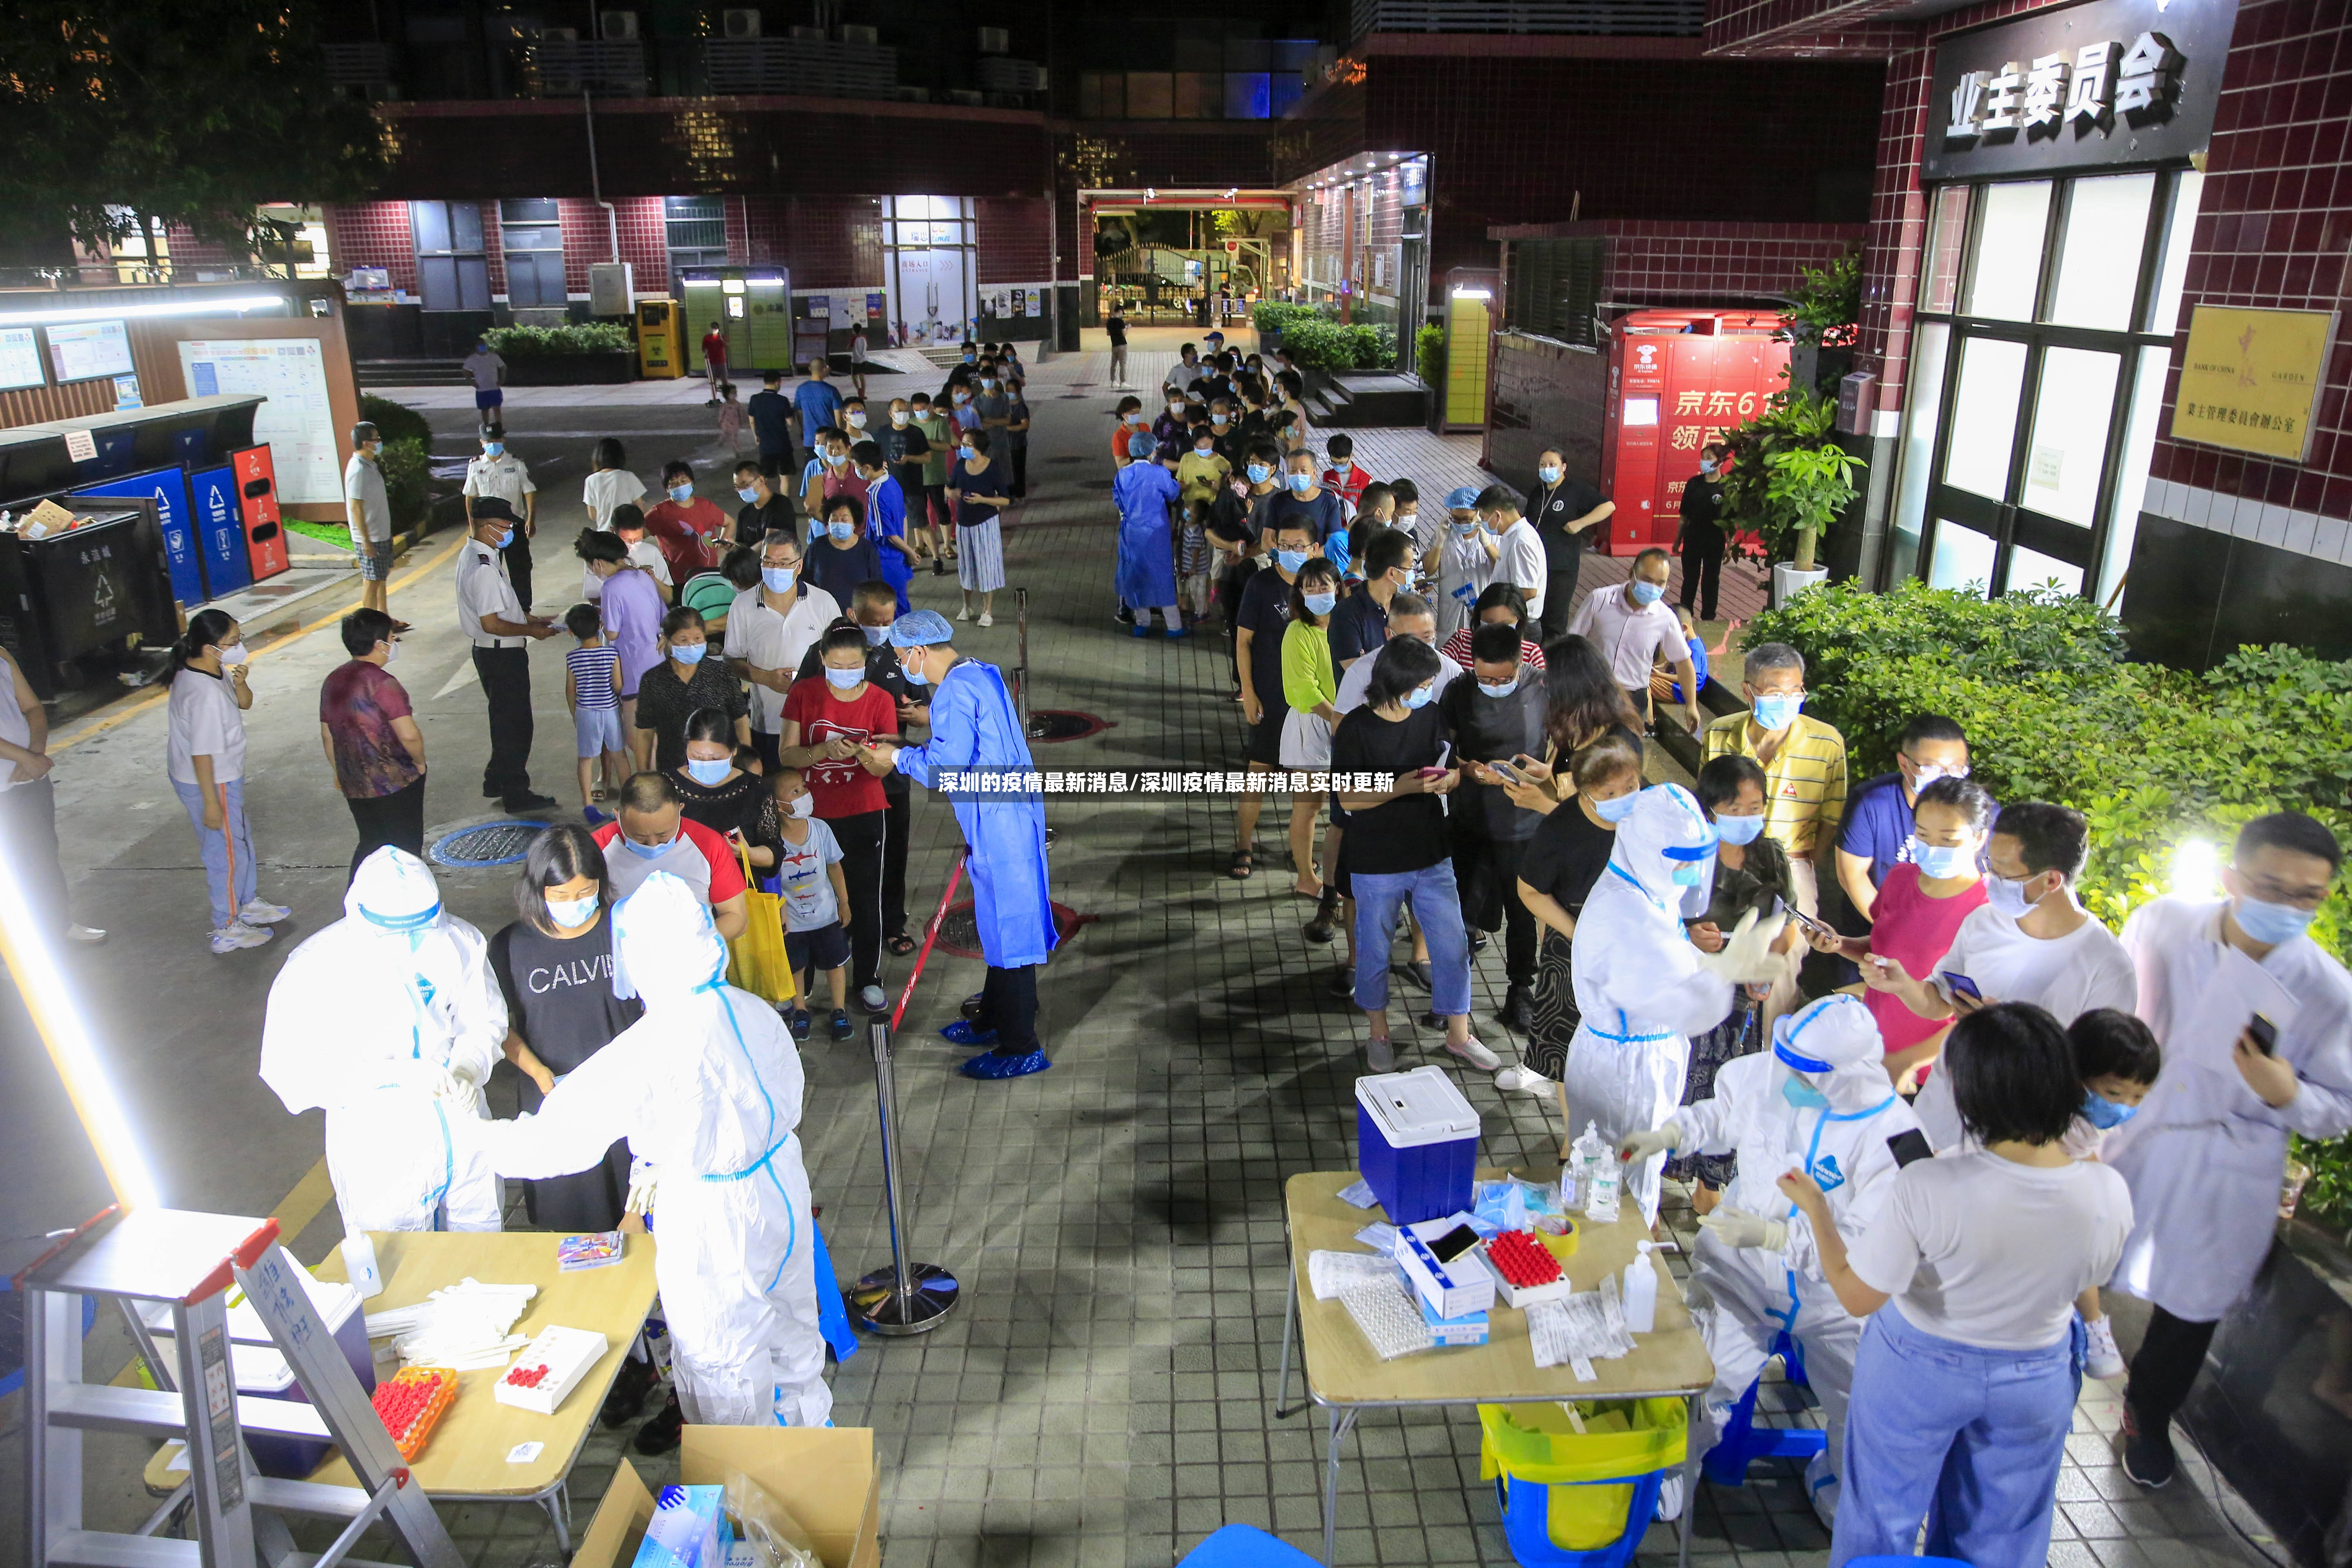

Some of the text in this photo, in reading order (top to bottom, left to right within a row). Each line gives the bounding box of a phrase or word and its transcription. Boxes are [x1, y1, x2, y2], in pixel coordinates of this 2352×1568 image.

[1947, 31, 2165, 137] 业主委员会
[911, 231, 928, 242] 瑞思
[2217, 366, 2235, 374] CHINA
[2272, 371, 2304, 381] GARDEN
[2188, 402, 2296, 434] 業主管理委員會辦公室
